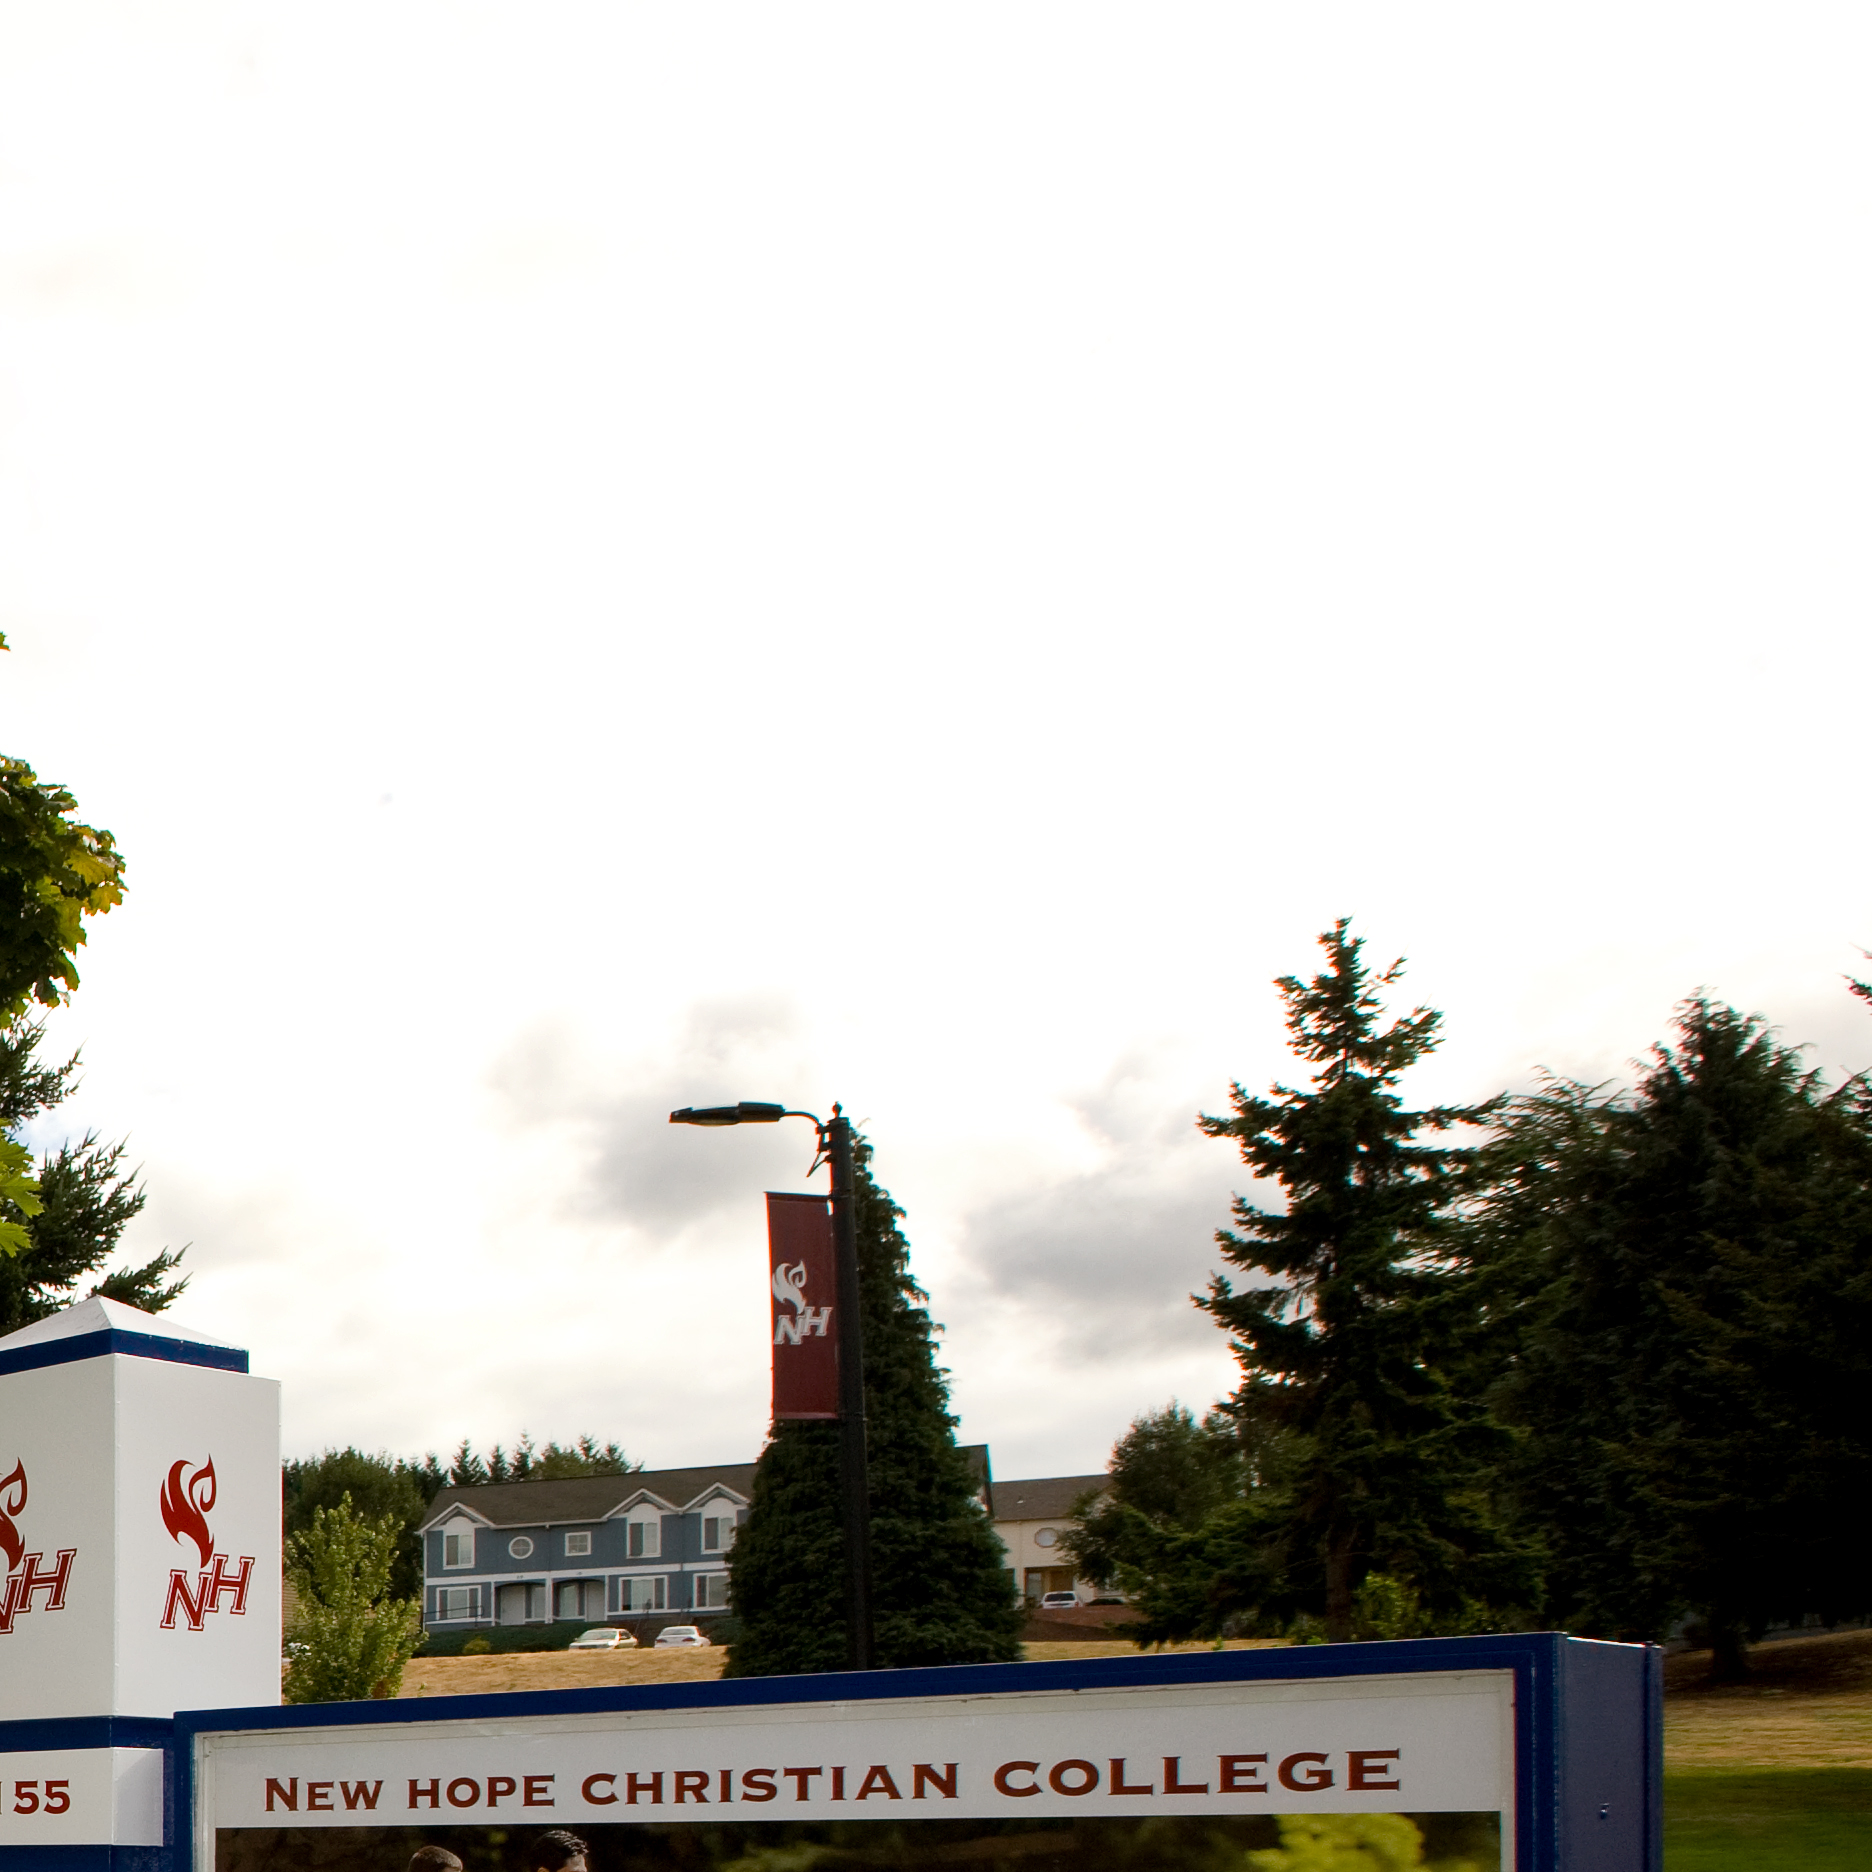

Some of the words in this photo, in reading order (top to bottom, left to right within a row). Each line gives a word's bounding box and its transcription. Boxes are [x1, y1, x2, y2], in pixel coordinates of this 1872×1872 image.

[774, 1306, 834, 1346] NH
[159, 1552, 256, 1632] NH
[265, 1777, 382, 1812] NEW
[408, 1776, 554, 1809] HOPE
[580, 1763, 956, 1806] CHRISTIAN
[992, 1750, 1400, 1798] COLLEGE
